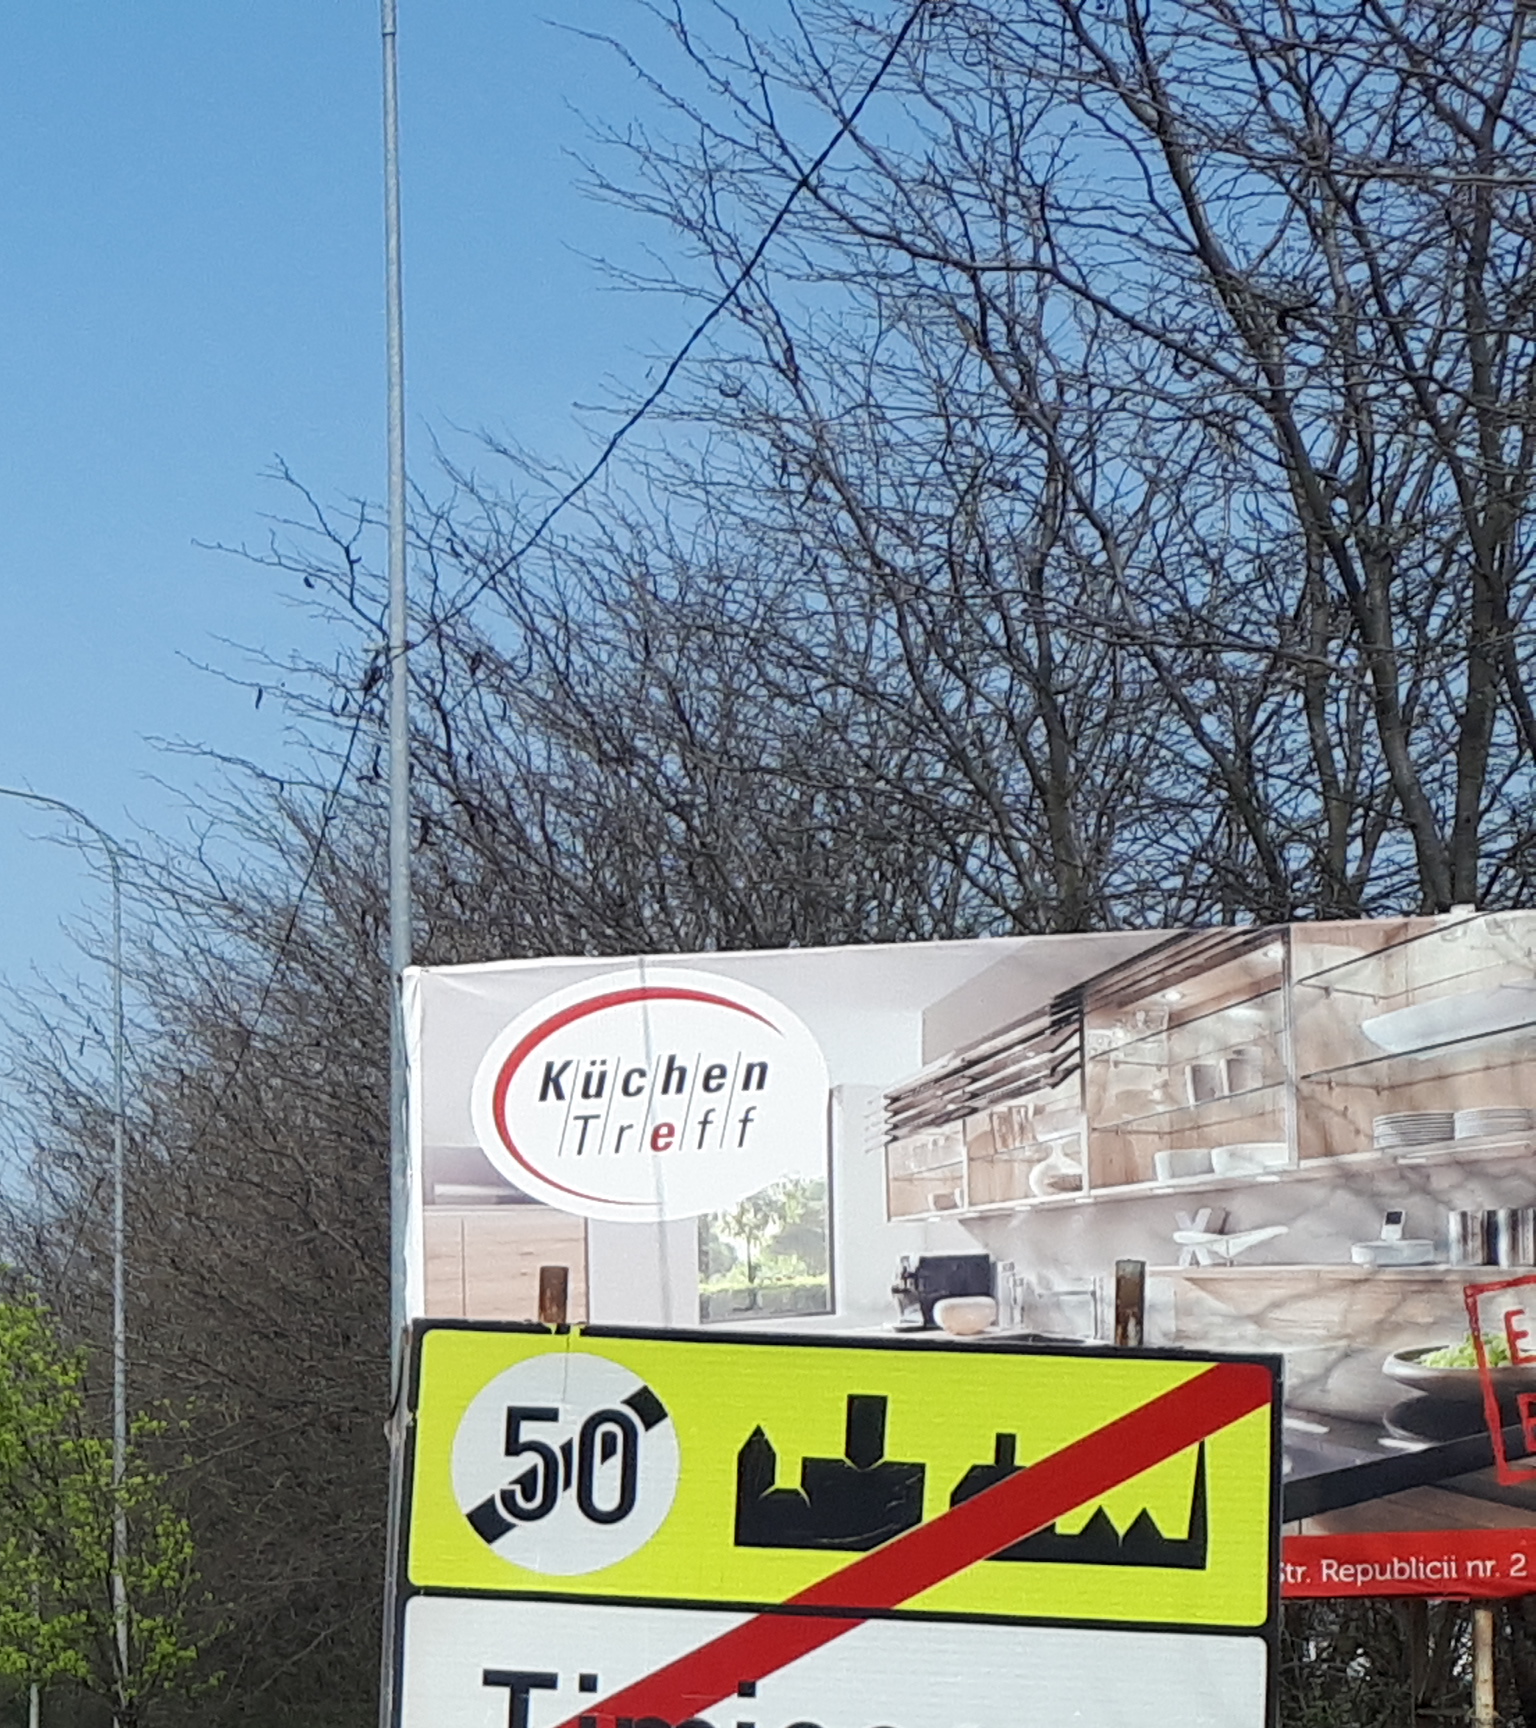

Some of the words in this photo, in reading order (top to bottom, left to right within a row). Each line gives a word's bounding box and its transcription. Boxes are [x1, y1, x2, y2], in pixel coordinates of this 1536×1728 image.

[538, 1054, 769, 1102] Küchen
[573, 1105, 757, 1156] Treff
[499, 1405, 639, 1525] 50
[1321, 1555, 1458, 1587] Republicii
[1466, 1558, 1501, 1578] nr.
[1510, 1553, 1528, 1577] 2
